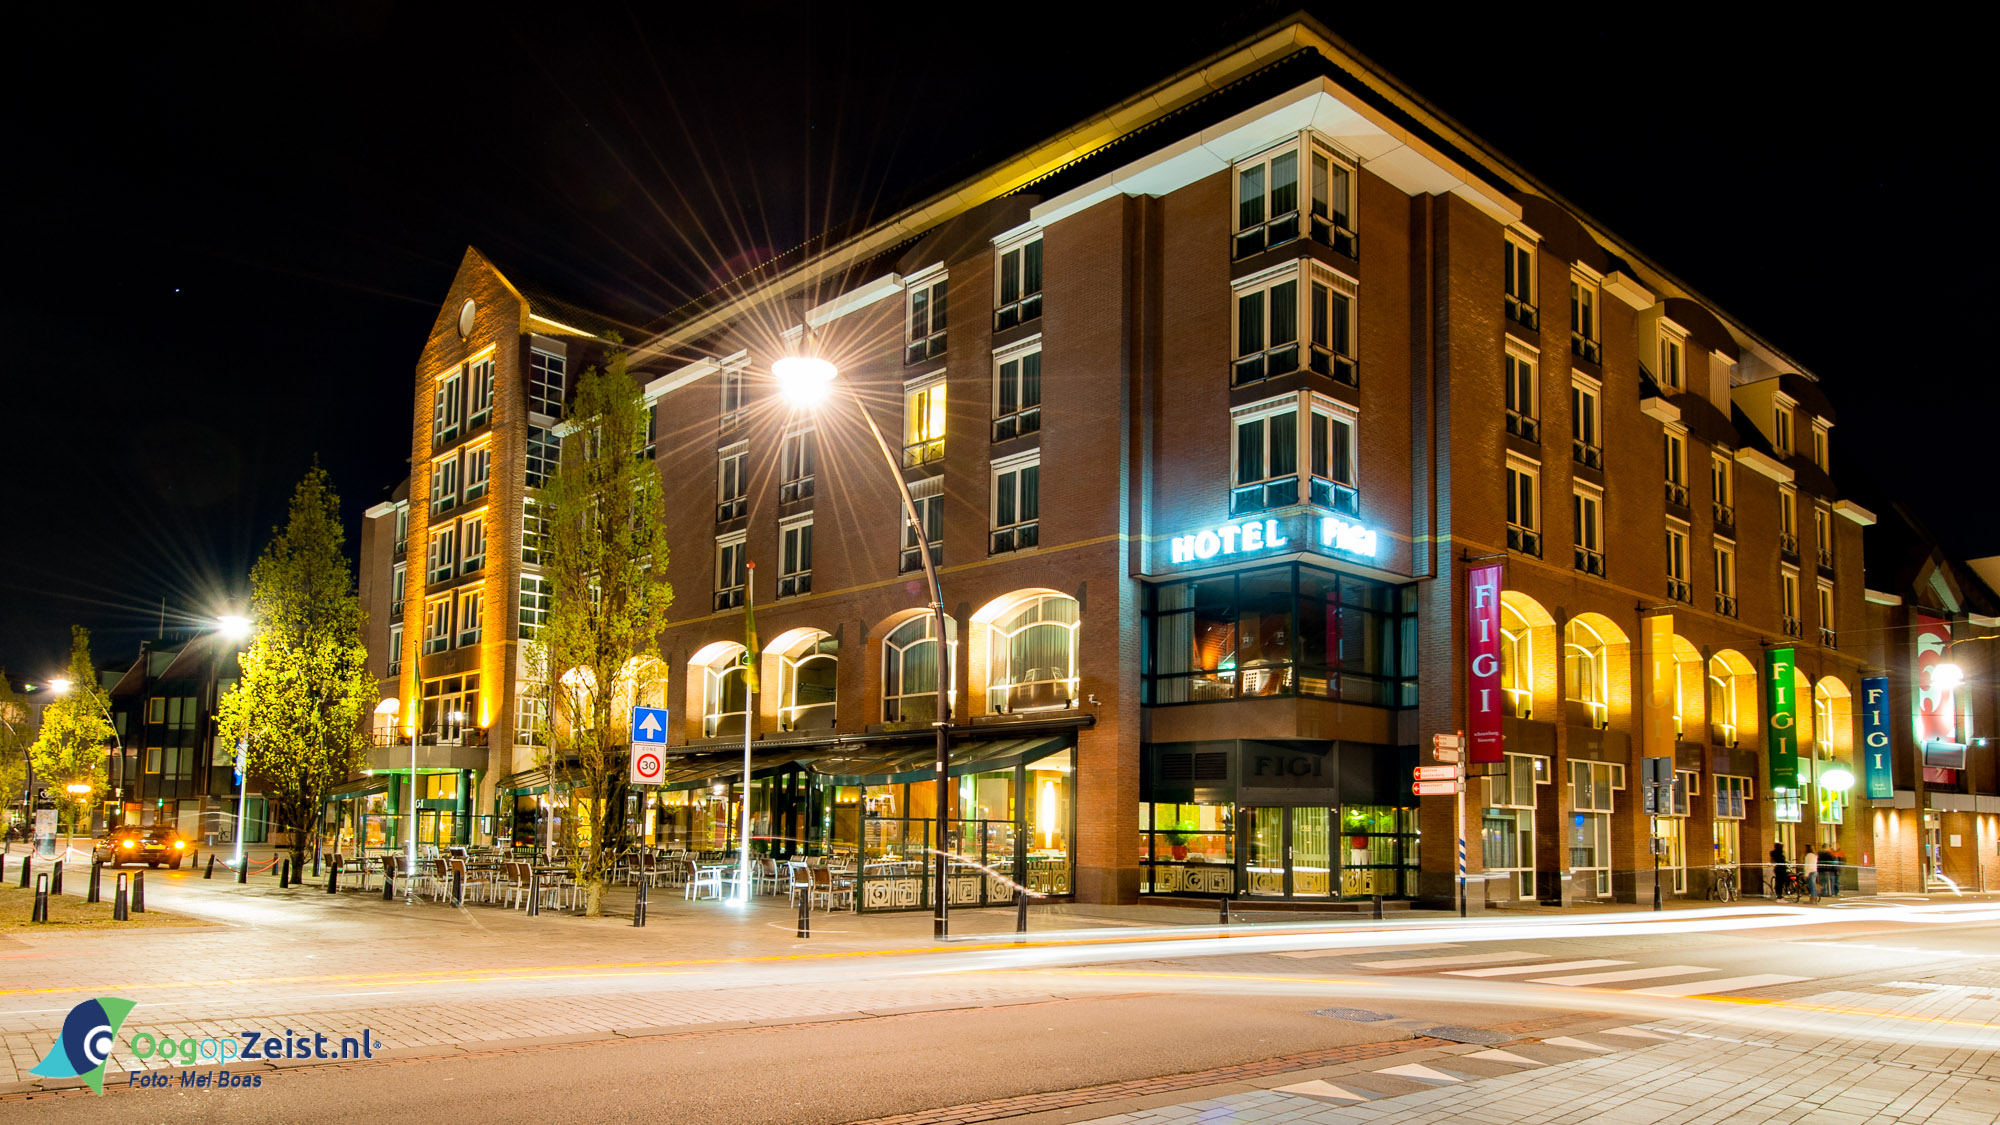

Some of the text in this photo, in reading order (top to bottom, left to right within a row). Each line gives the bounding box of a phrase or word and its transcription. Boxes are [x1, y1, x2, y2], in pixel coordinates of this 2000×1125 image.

[1171, 519, 1287, 564] HOTEL
[1320, 517, 1377, 557] FIGI
[1472, 584, 1499, 713] FIGI
[1771, 662, 1794, 755] FIGI
[1866, 688, 1889, 769] FIGI
[641, 760, 656, 771] 30
[1254, 755, 1322, 777] FIGI
